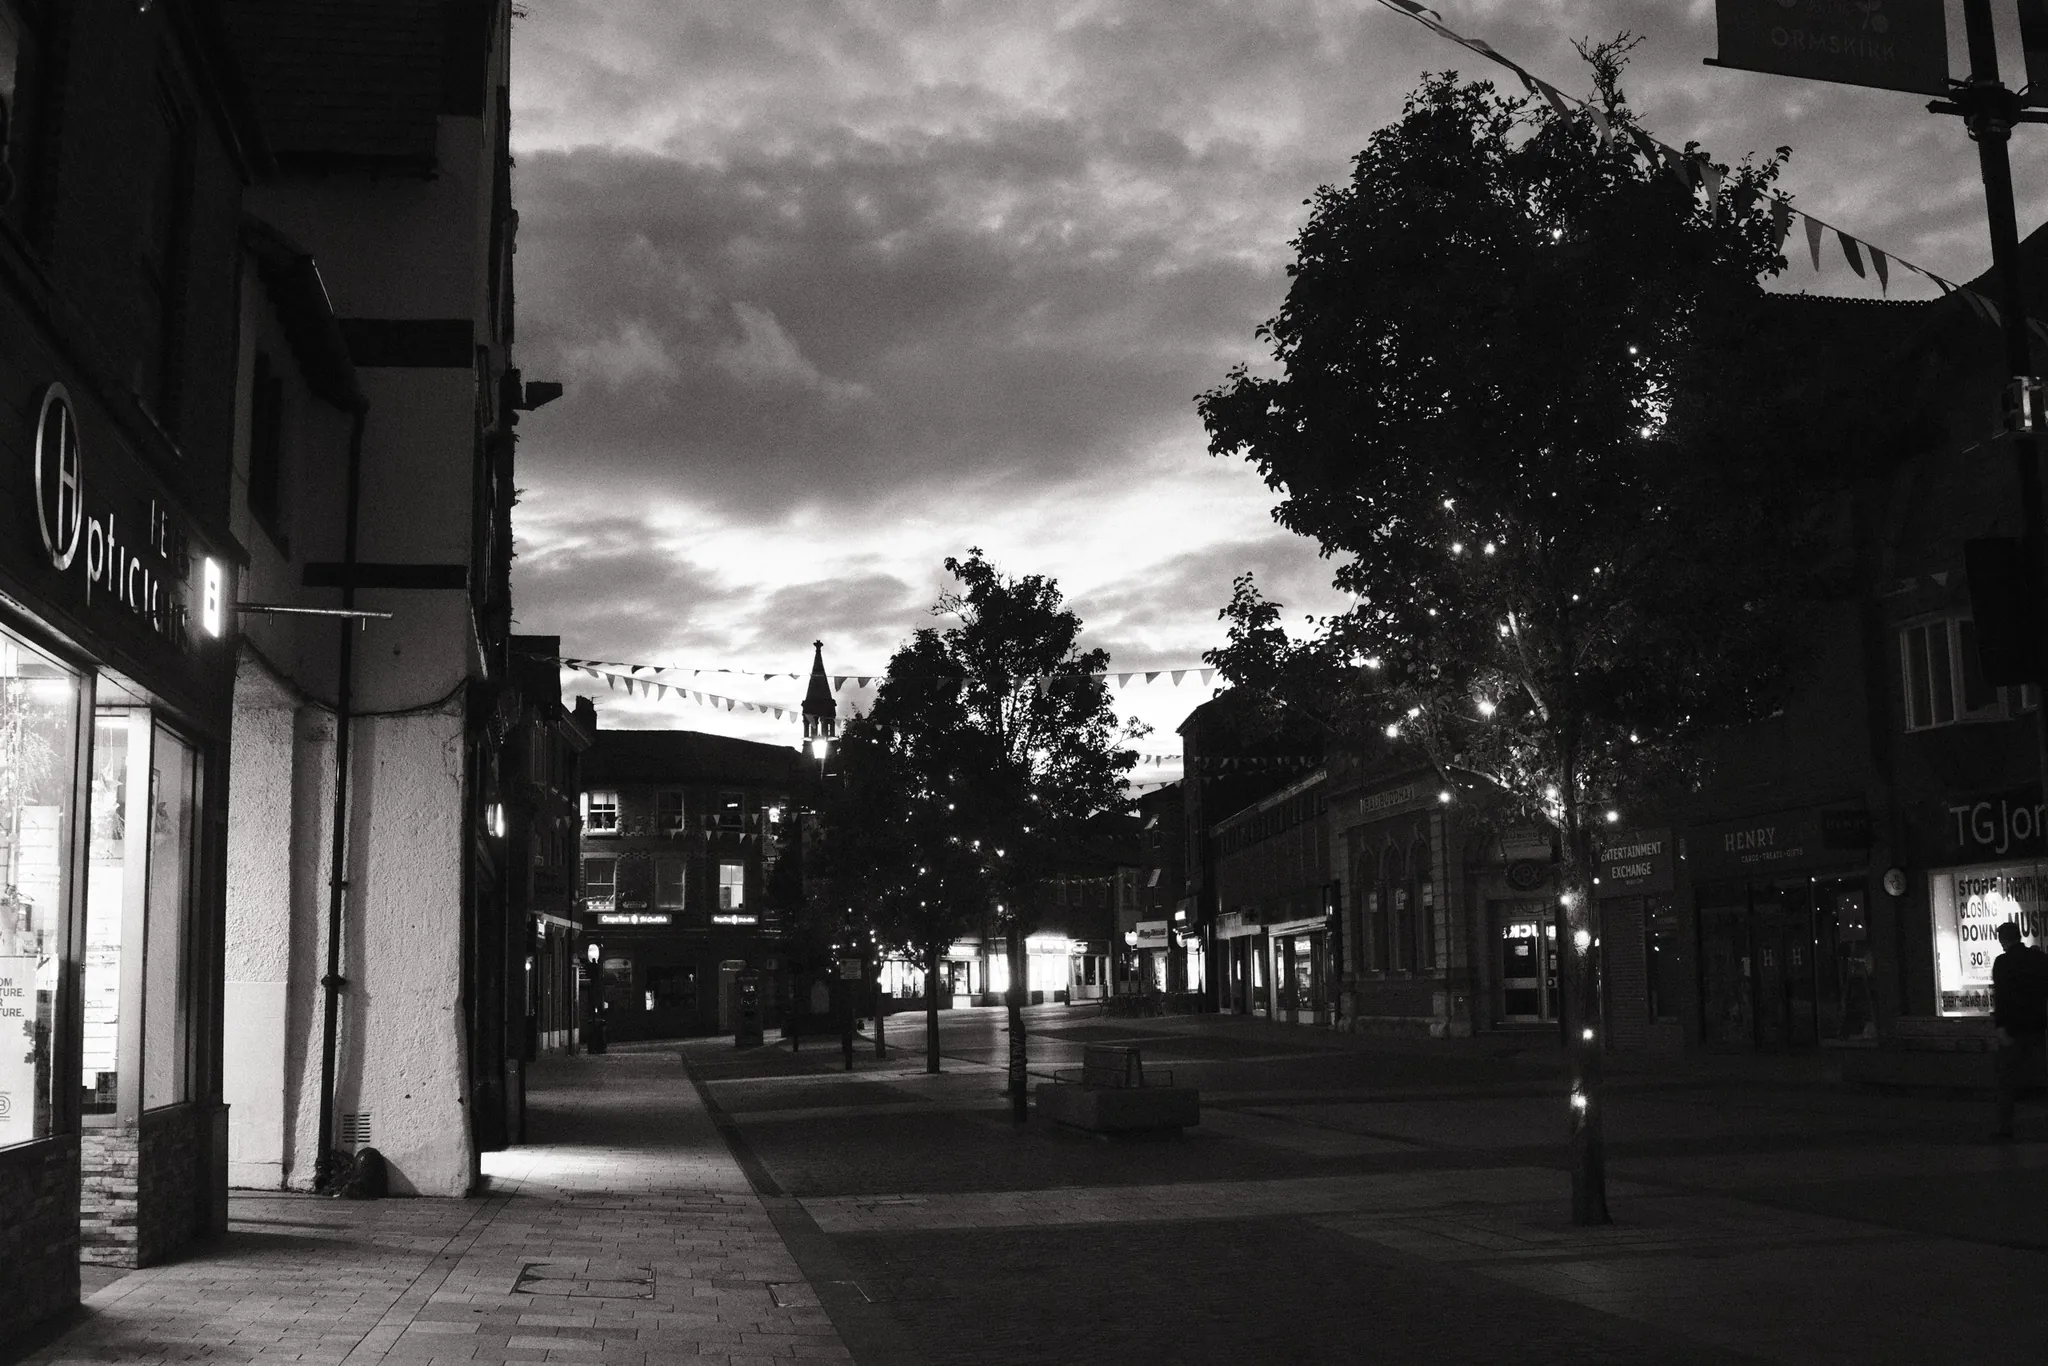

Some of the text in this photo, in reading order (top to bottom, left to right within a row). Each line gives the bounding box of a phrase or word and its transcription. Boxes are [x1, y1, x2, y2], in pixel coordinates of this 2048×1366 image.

[1725, 828, 1776, 851] HENRY
[1612, 862, 1652, 879] EXCHANGE
[1959, 877, 1998, 897] STORE
[1960, 901, 1998, 919] CLOSING
[1961, 923, 1999, 942] DOWN
